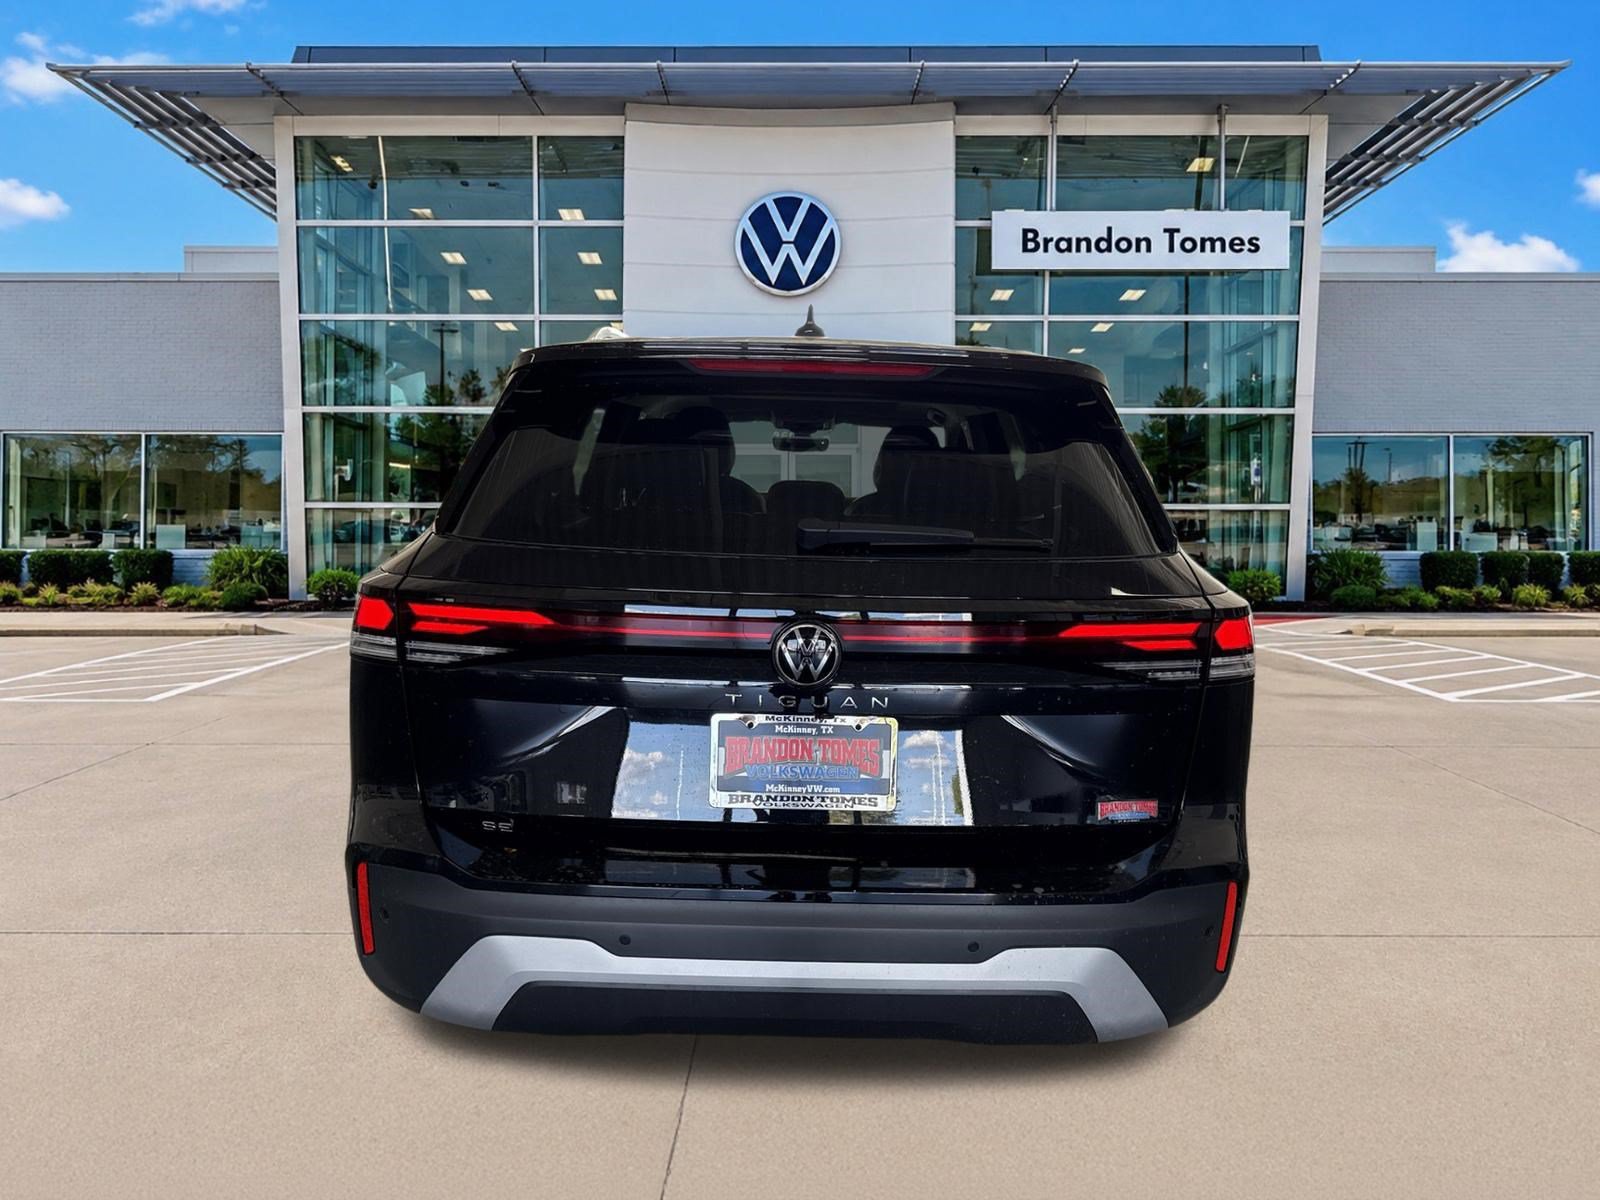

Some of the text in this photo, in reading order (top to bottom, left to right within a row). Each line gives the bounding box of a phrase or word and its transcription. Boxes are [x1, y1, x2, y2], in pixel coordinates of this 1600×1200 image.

[740, 194, 837, 290] VW
[1021, 226, 1261, 254] Brandon Tomes
[777, 625, 838, 684] VW
[725, 693, 889, 709] TIGUAN
[774, 724, 834, 735] McKinney, TX
[725, 736, 881, 777] BRANDON TOMES
[745, 764, 860, 780] VOLKSWAGEN
[765, 783, 841, 794] McKinneyVW.com
[728, 794, 878, 807] BRANDON TOMES
